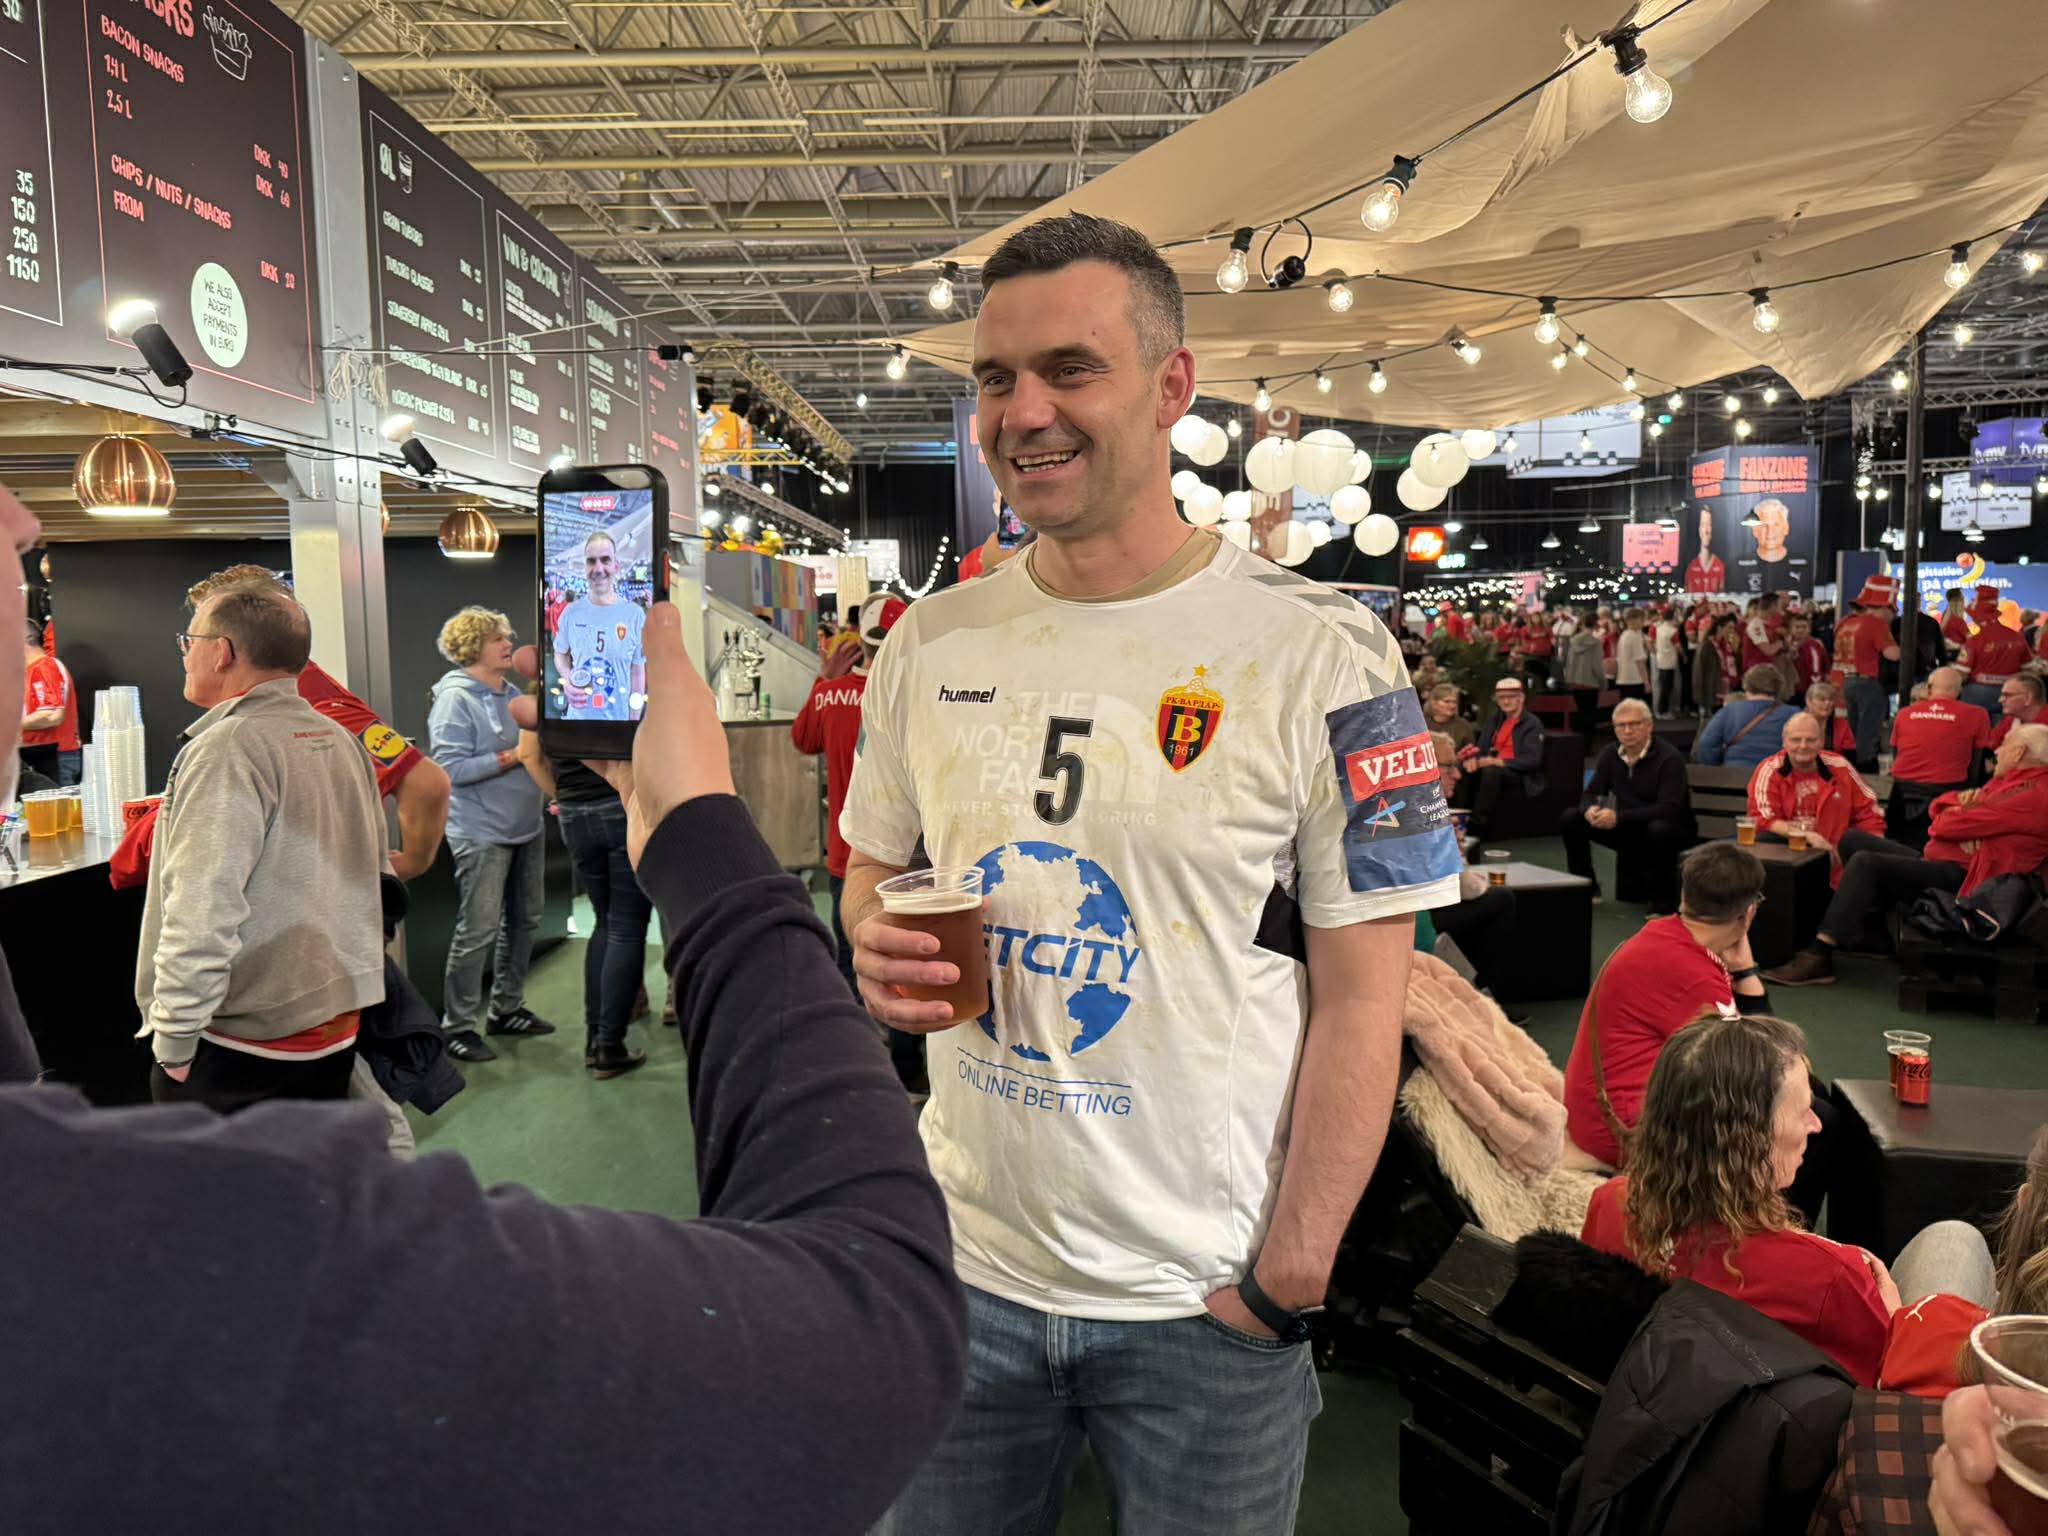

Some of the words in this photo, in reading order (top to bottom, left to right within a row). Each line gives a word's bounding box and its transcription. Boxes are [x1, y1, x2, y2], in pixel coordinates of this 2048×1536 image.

[101, 14, 140, 58] BACON
[142, 43, 185, 84] SNACKS
[104, 54, 119, 78] 1,4
[121, 62, 129, 83] L
[107, 89, 123, 114] 2,5
[125, 99, 134, 120] L
[15, 168, 34, 197] 35
[111, 154, 144, 187] CHIPS
[155, 176, 184, 205] NUTS
[193, 197, 232, 230] SNACKS
[10, 195, 36, 225] 150
[113, 189, 145, 222] FROM
[12, 225, 38, 255] 250
[6, 253, 40, 283] 1150
[1739, 456, 1809, 481] FANZONE
[596, 630, 606, 653] 5
[815, 687, 866, 712] DANM
[938, 684, 997, 704] hummel
[1017, 691, 1093, 722] THE
[1168, 743, 1195, 758] 1961
[1358, 741, 1439, 785] VELU
[1033, 715, 1094, 826] 5
[958, 1060, 1020, 1102] ONLINE
[1023, 1086, 1133, 1117] BETTING
